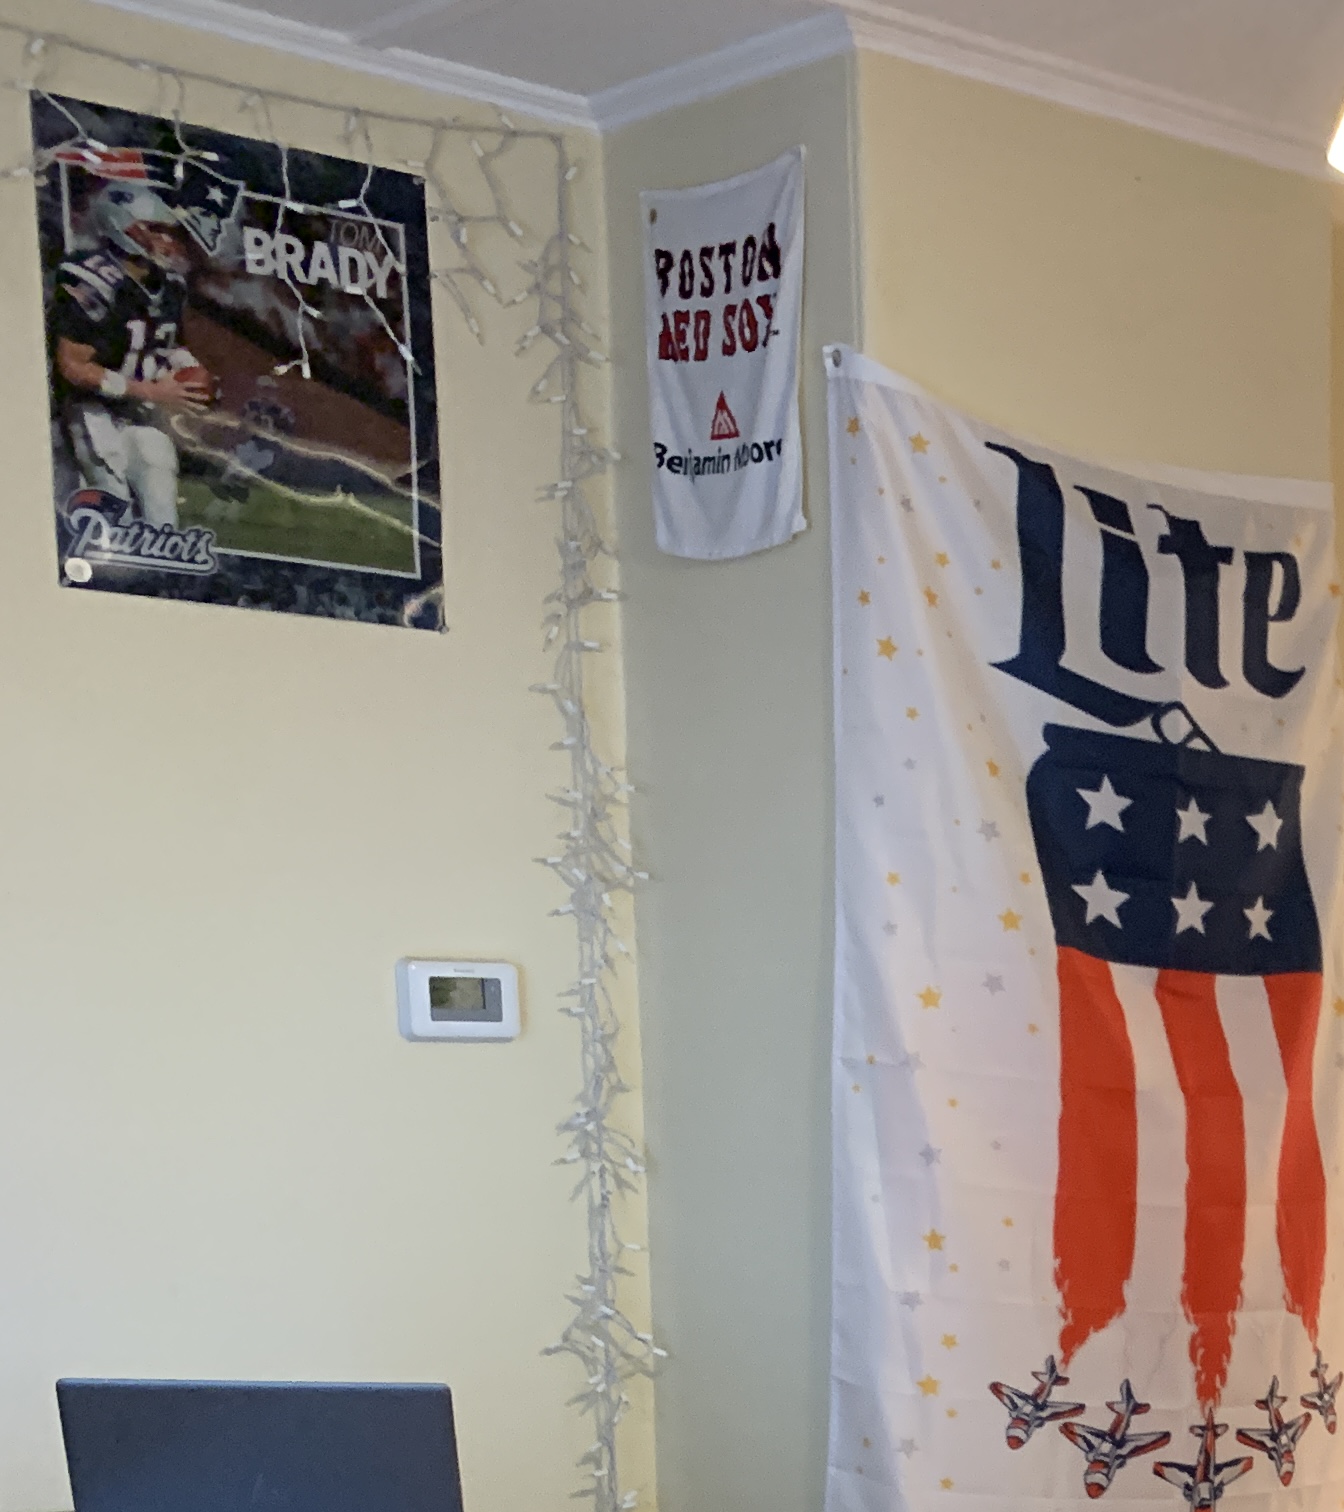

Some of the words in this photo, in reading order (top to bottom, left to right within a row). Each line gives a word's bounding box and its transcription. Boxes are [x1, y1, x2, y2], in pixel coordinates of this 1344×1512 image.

[243, 226, 394, 299] BRADY
[328, 219, 382, 250] TOM
[70, 508, 215, 567] Patriots
[984, 441, 1307, 728] Lite
